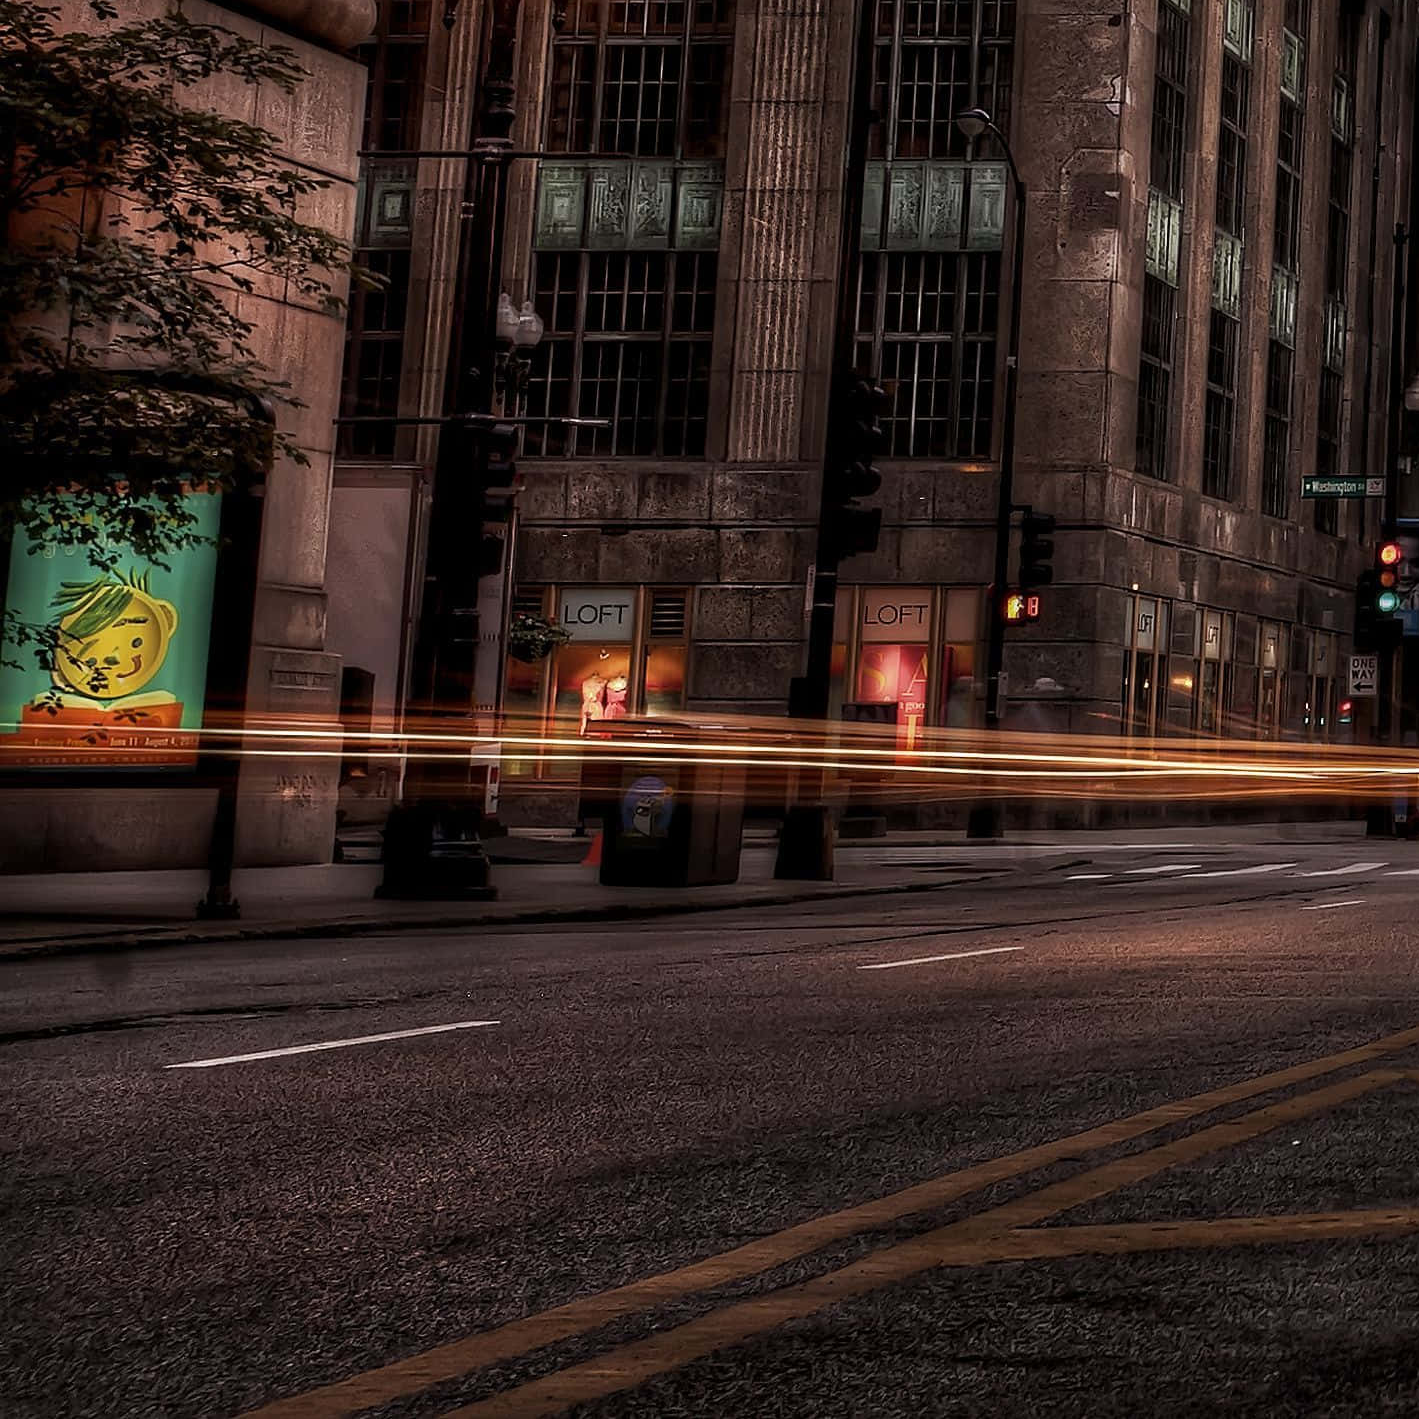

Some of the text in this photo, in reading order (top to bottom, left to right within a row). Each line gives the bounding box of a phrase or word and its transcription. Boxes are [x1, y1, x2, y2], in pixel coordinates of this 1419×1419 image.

[1312, 481, 1357, 497] Washington
[564, 604, 629, 624] LOFT
[864, 604, 929, 625] LOFT
[1352, 658, 1375, 668] ONE
[1352, 670, 1375, 679] WAY
